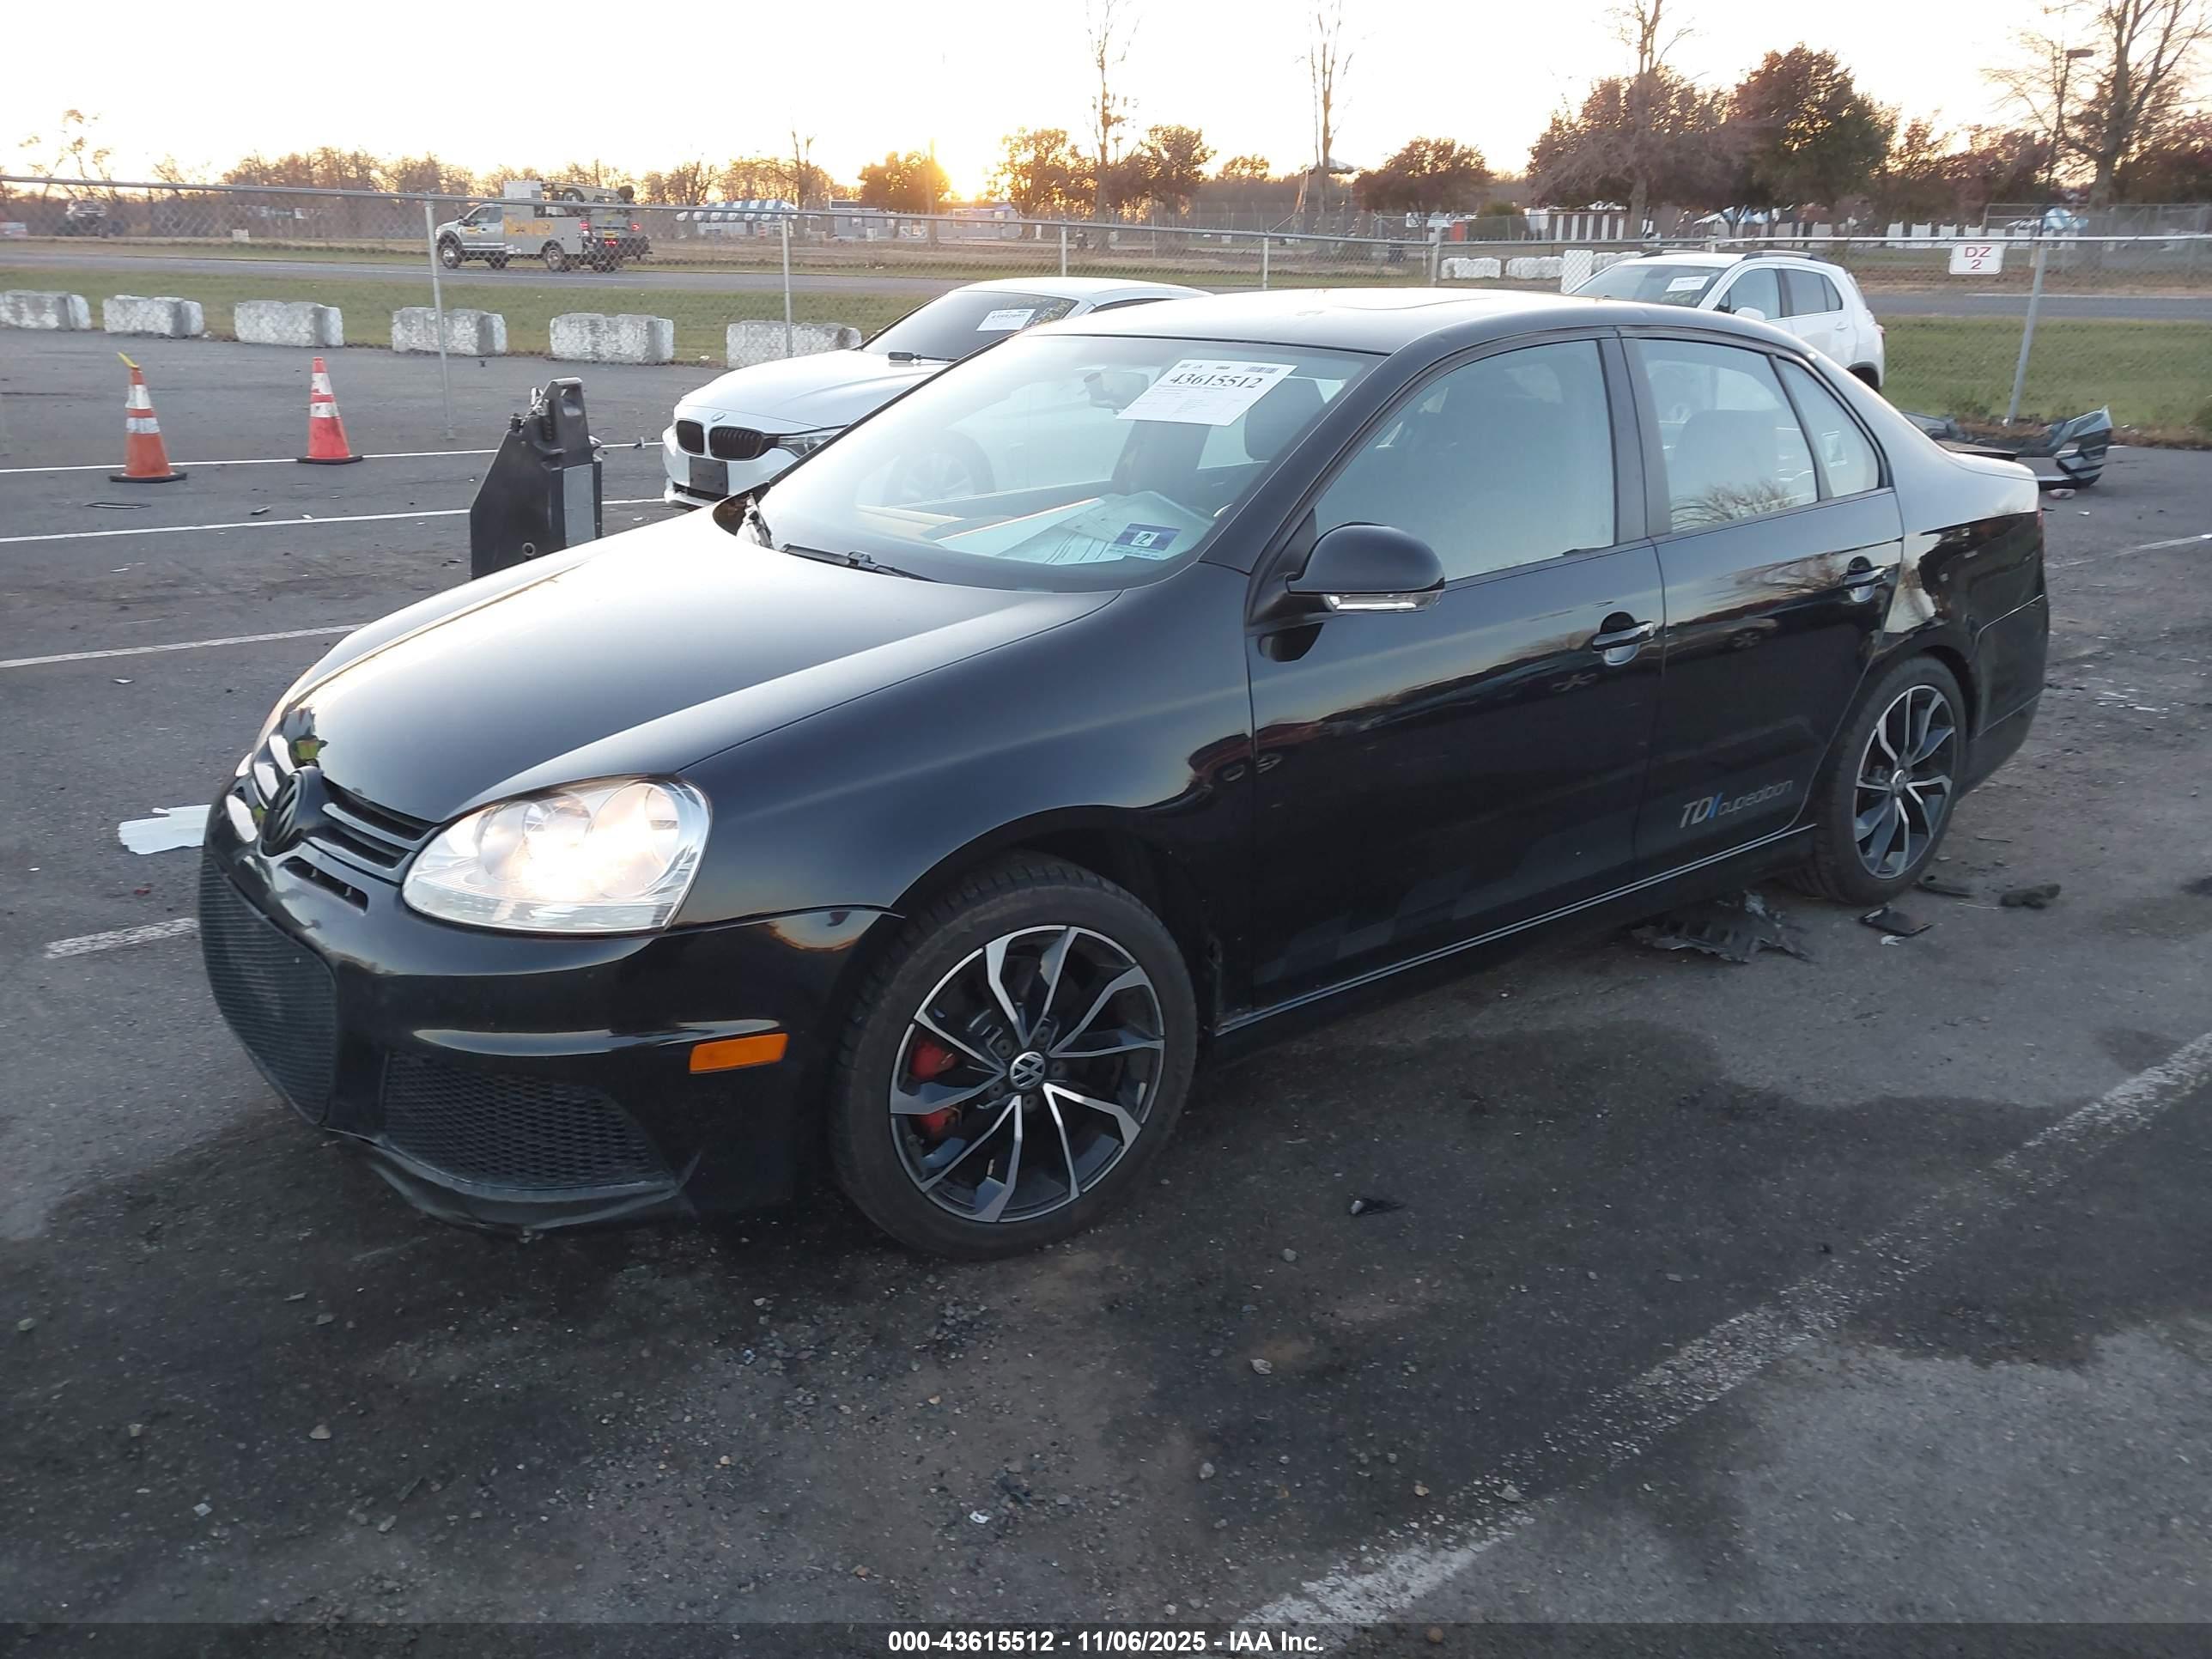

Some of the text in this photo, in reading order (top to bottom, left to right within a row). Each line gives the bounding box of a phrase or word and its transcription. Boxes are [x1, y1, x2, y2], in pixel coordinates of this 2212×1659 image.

[1964, 246, 1992, 258] DZ
[1970, 258, 1983, 270] 2
[1169, 372, 1264, 389] 43615512
[1137, 532, 1152, 544] 2
